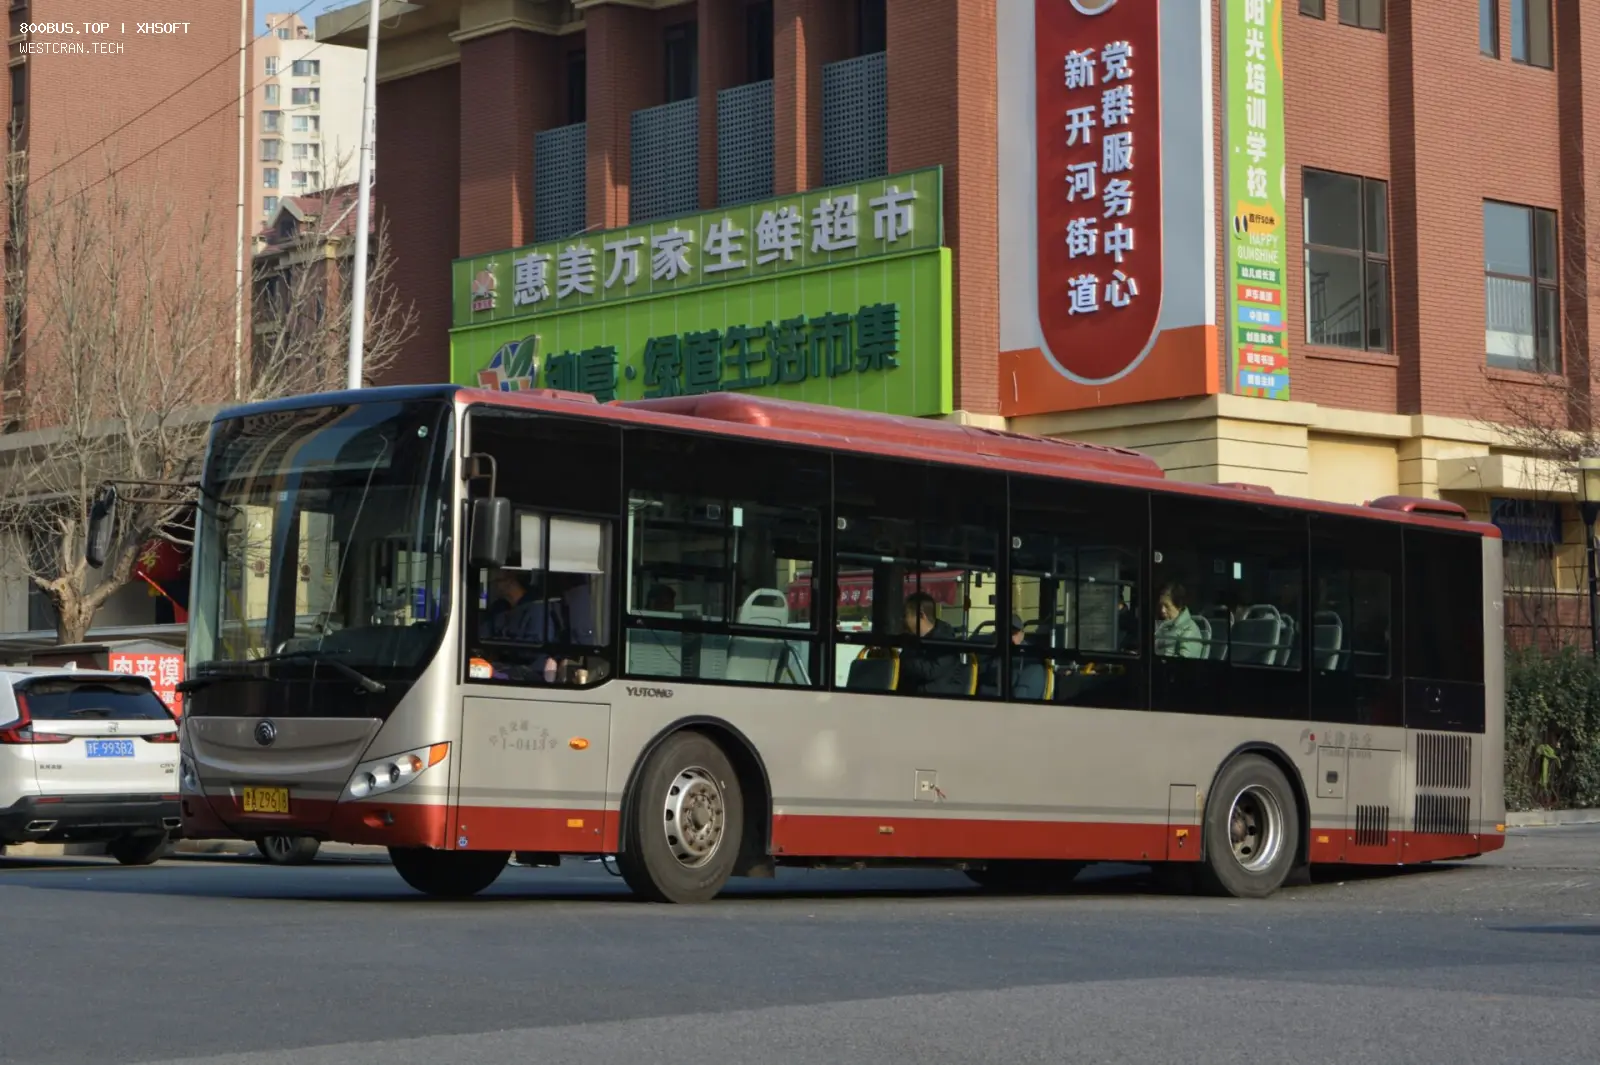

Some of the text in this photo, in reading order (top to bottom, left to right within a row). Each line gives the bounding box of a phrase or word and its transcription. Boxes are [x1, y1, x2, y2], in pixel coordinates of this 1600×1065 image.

[1064, 48, 1100, 316] 新开河街道
[1101, 40, 1139, 309] 党群服务中心
[1248, 213, 1275, 225] 直行50米
[513, 185, 918, 306] 惠美万家生鲜超市
[1249, 231, 1279, 250] HAPPY
[1237, 245, 1279, 265] SUNSHINE
[113, 655, 179, 687] 肉夹馍
[626, 686, 674, 699] YUTONG
